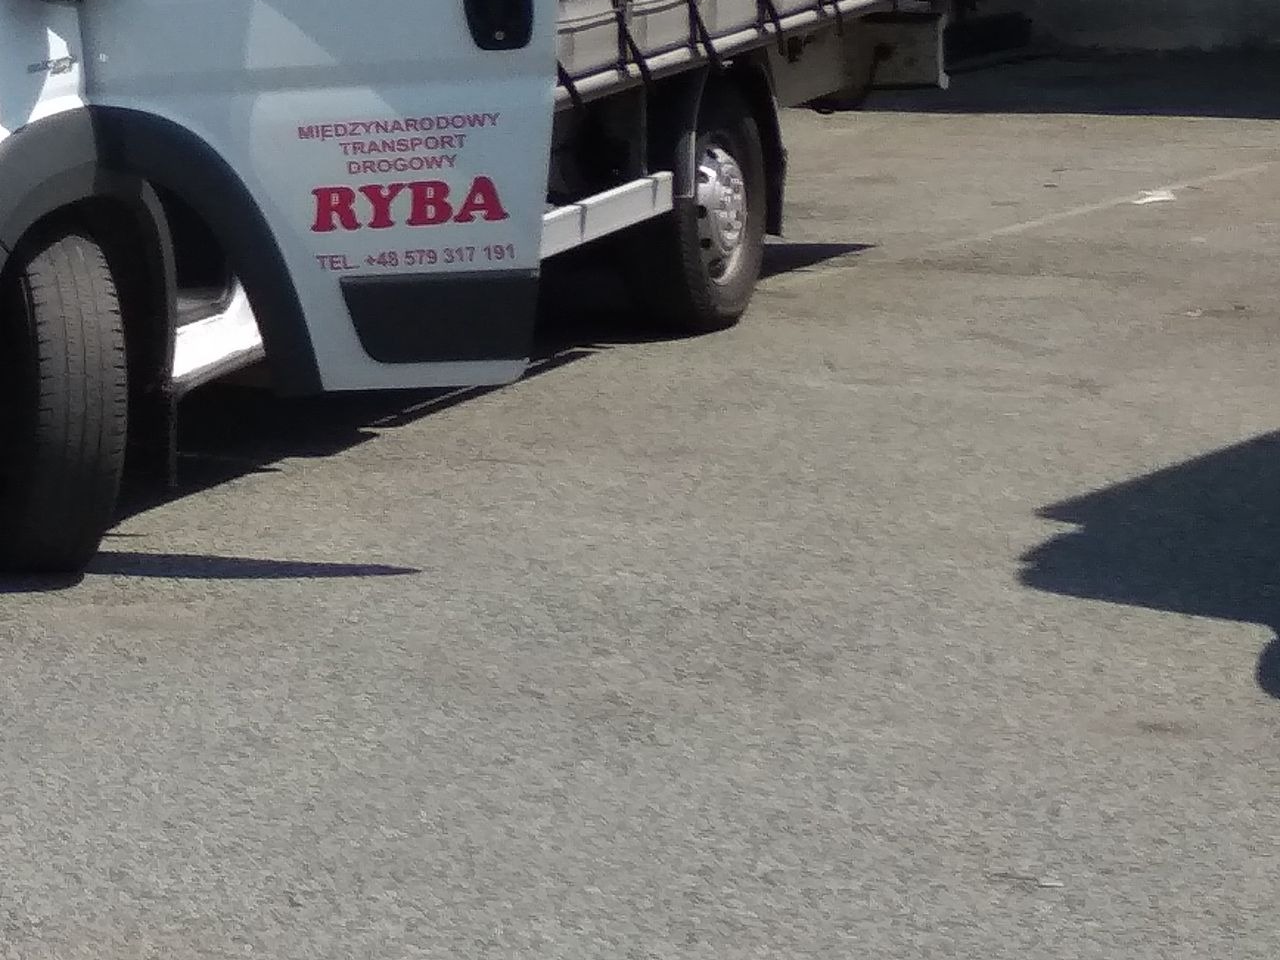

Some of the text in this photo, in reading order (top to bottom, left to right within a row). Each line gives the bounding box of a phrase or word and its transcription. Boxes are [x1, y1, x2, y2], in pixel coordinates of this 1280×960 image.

[297, 112, 501, 141] MIĘDZYNARODOWY
[338, 134, 468, 156] TRANSPORT
[348, 154, 458, 175] DROGOWY
[310, 175, 510, 233] RYBA
[365, 249, 399, 268] +48
[403, 248, 437, 266] 579
[443, 246, 476, 264] 317
[483, 243, 516, 261] 191
